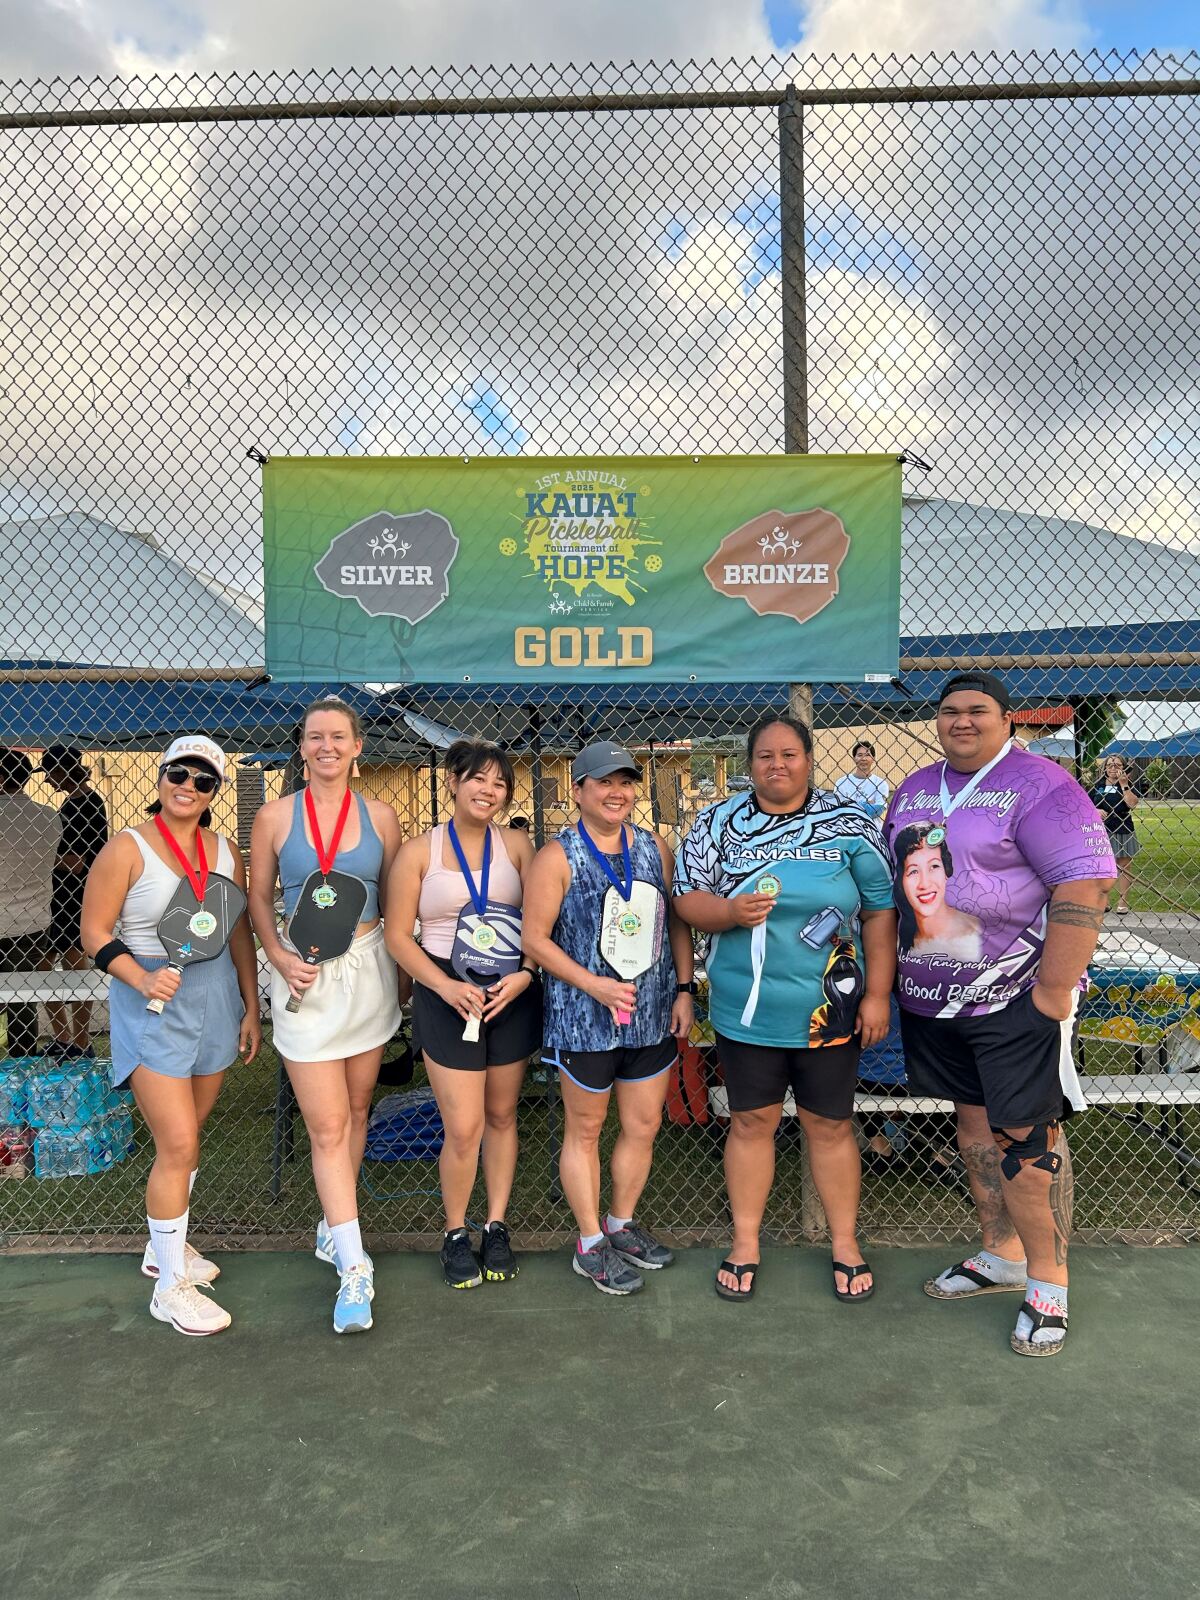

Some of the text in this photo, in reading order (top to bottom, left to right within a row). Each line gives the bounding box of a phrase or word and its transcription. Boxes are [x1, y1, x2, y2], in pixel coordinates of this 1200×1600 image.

[535, 470, 627, 490] 1ST ANNUAL
[520, 515, 641, 543] Pickleball
[544, 543, 619, 553] Tournament of
[340, 565, 434, 585] SILVER
[537, 554, 626, 580] HOPE
[723, 563, 829, 585] BRONZE
[514, 626, 653, 667] GOLD
[922, 952, 997, 977] Taniguchi
[904, 977, 942, 1001] Good
